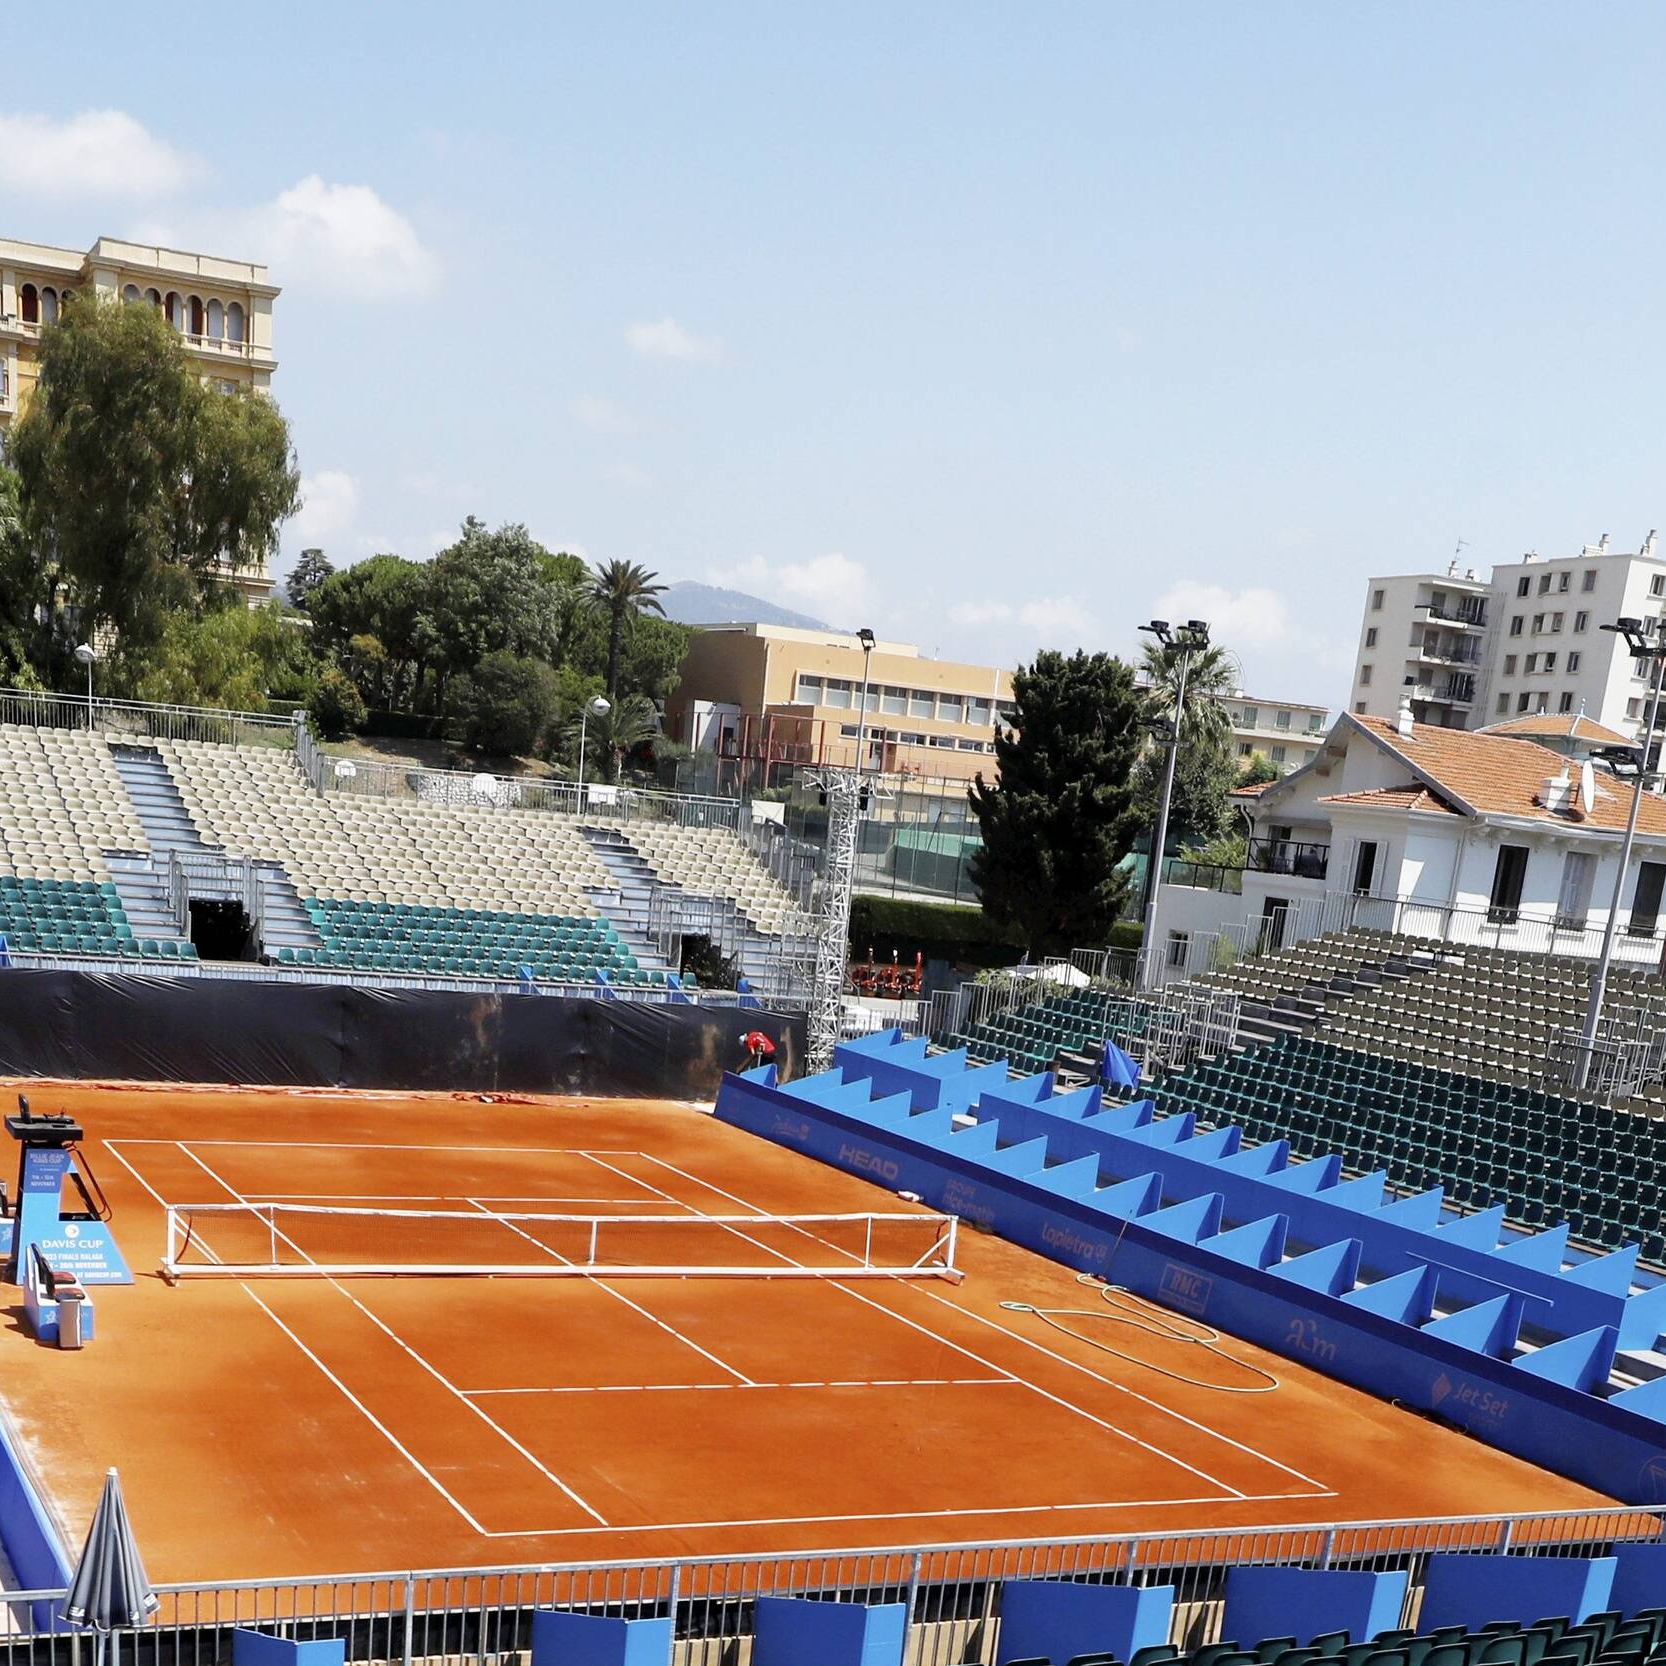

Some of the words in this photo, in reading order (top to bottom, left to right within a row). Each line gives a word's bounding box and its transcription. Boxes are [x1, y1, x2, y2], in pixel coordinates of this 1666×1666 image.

[838, 1143, 902, 1182] HEAD
[42, 1239, 76, 1249] DAVIS
[78, 1239, 104, 1249] CUP
[1041, 1221, 1094, 1260] lapietra
[1169, 1270, 1202, 1299] RMC
[1453, 1383, 1480, 1408] Jet
[1481, 1391, 1510, 1419] Set
